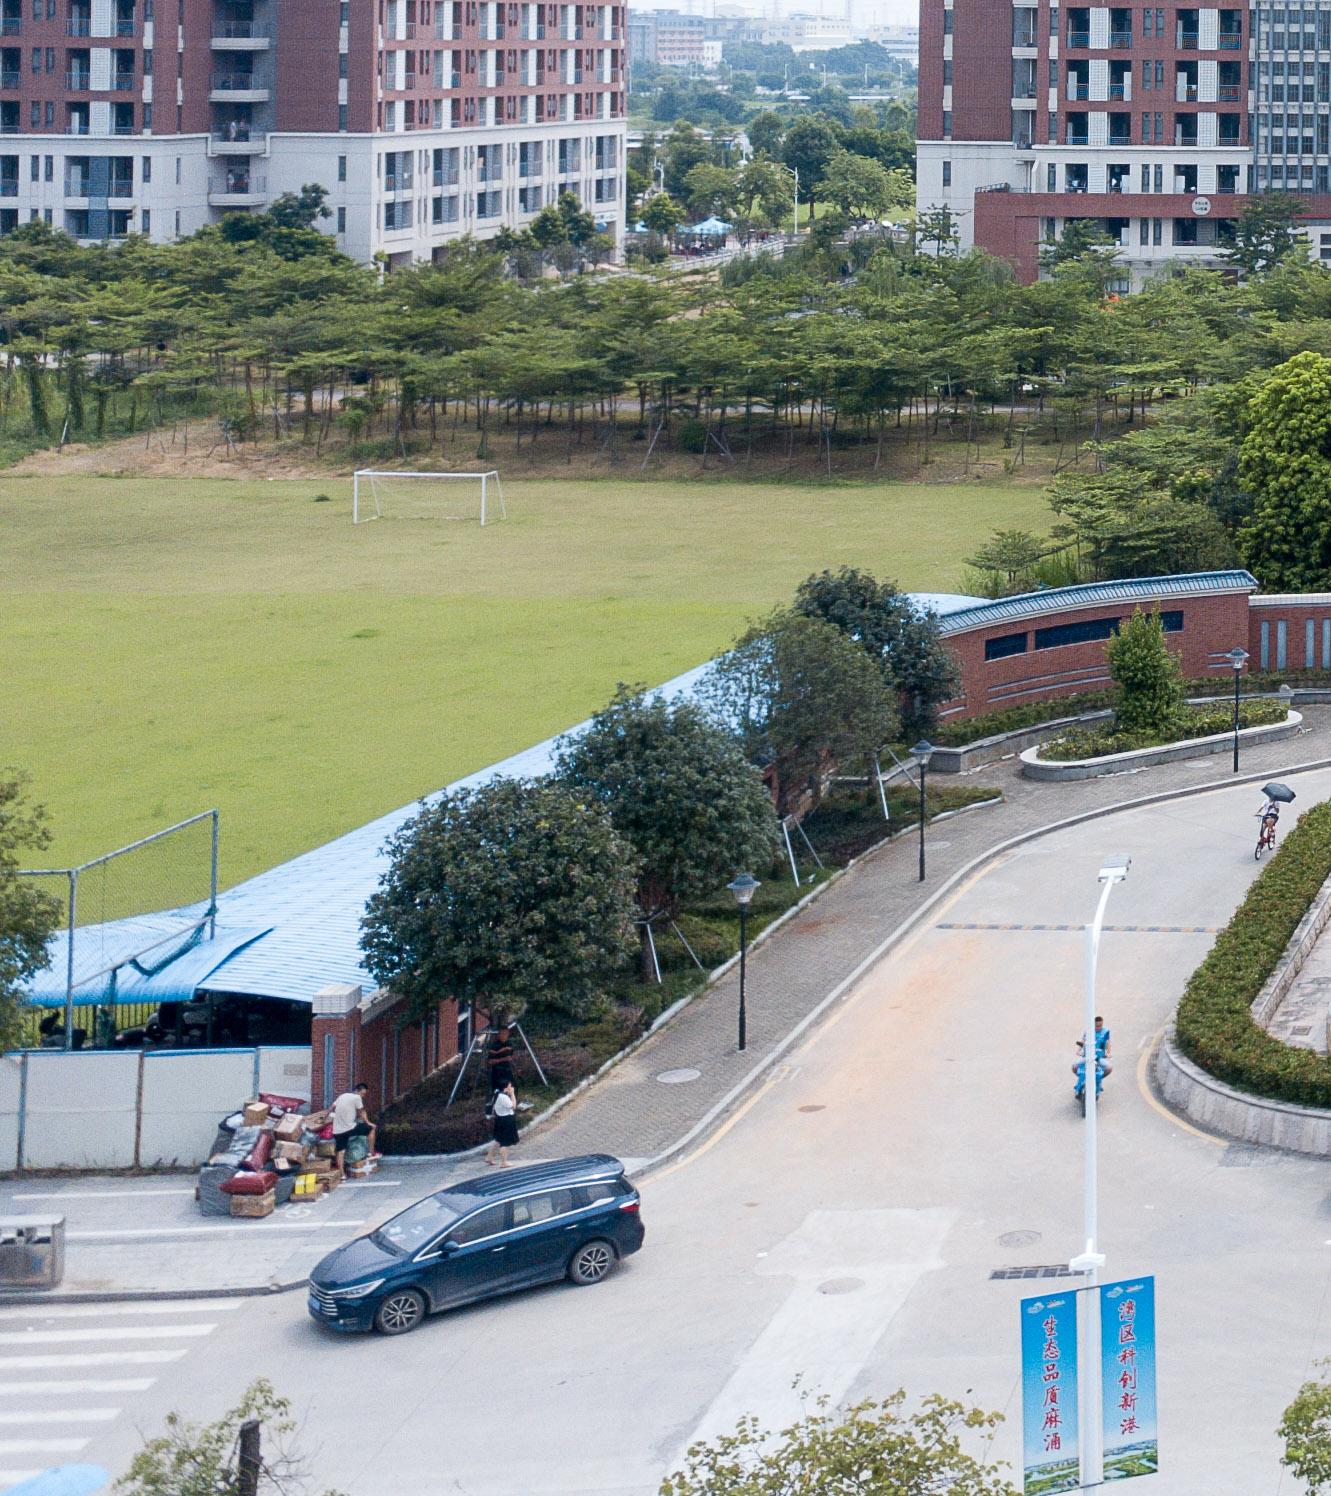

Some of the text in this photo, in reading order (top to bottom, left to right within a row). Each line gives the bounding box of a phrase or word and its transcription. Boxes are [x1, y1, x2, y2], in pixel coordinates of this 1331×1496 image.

[1041, 1314, 1064, 1452] 生态品质麻涌
[1118, 1299, 1141, 1436] 湾区科创新港
